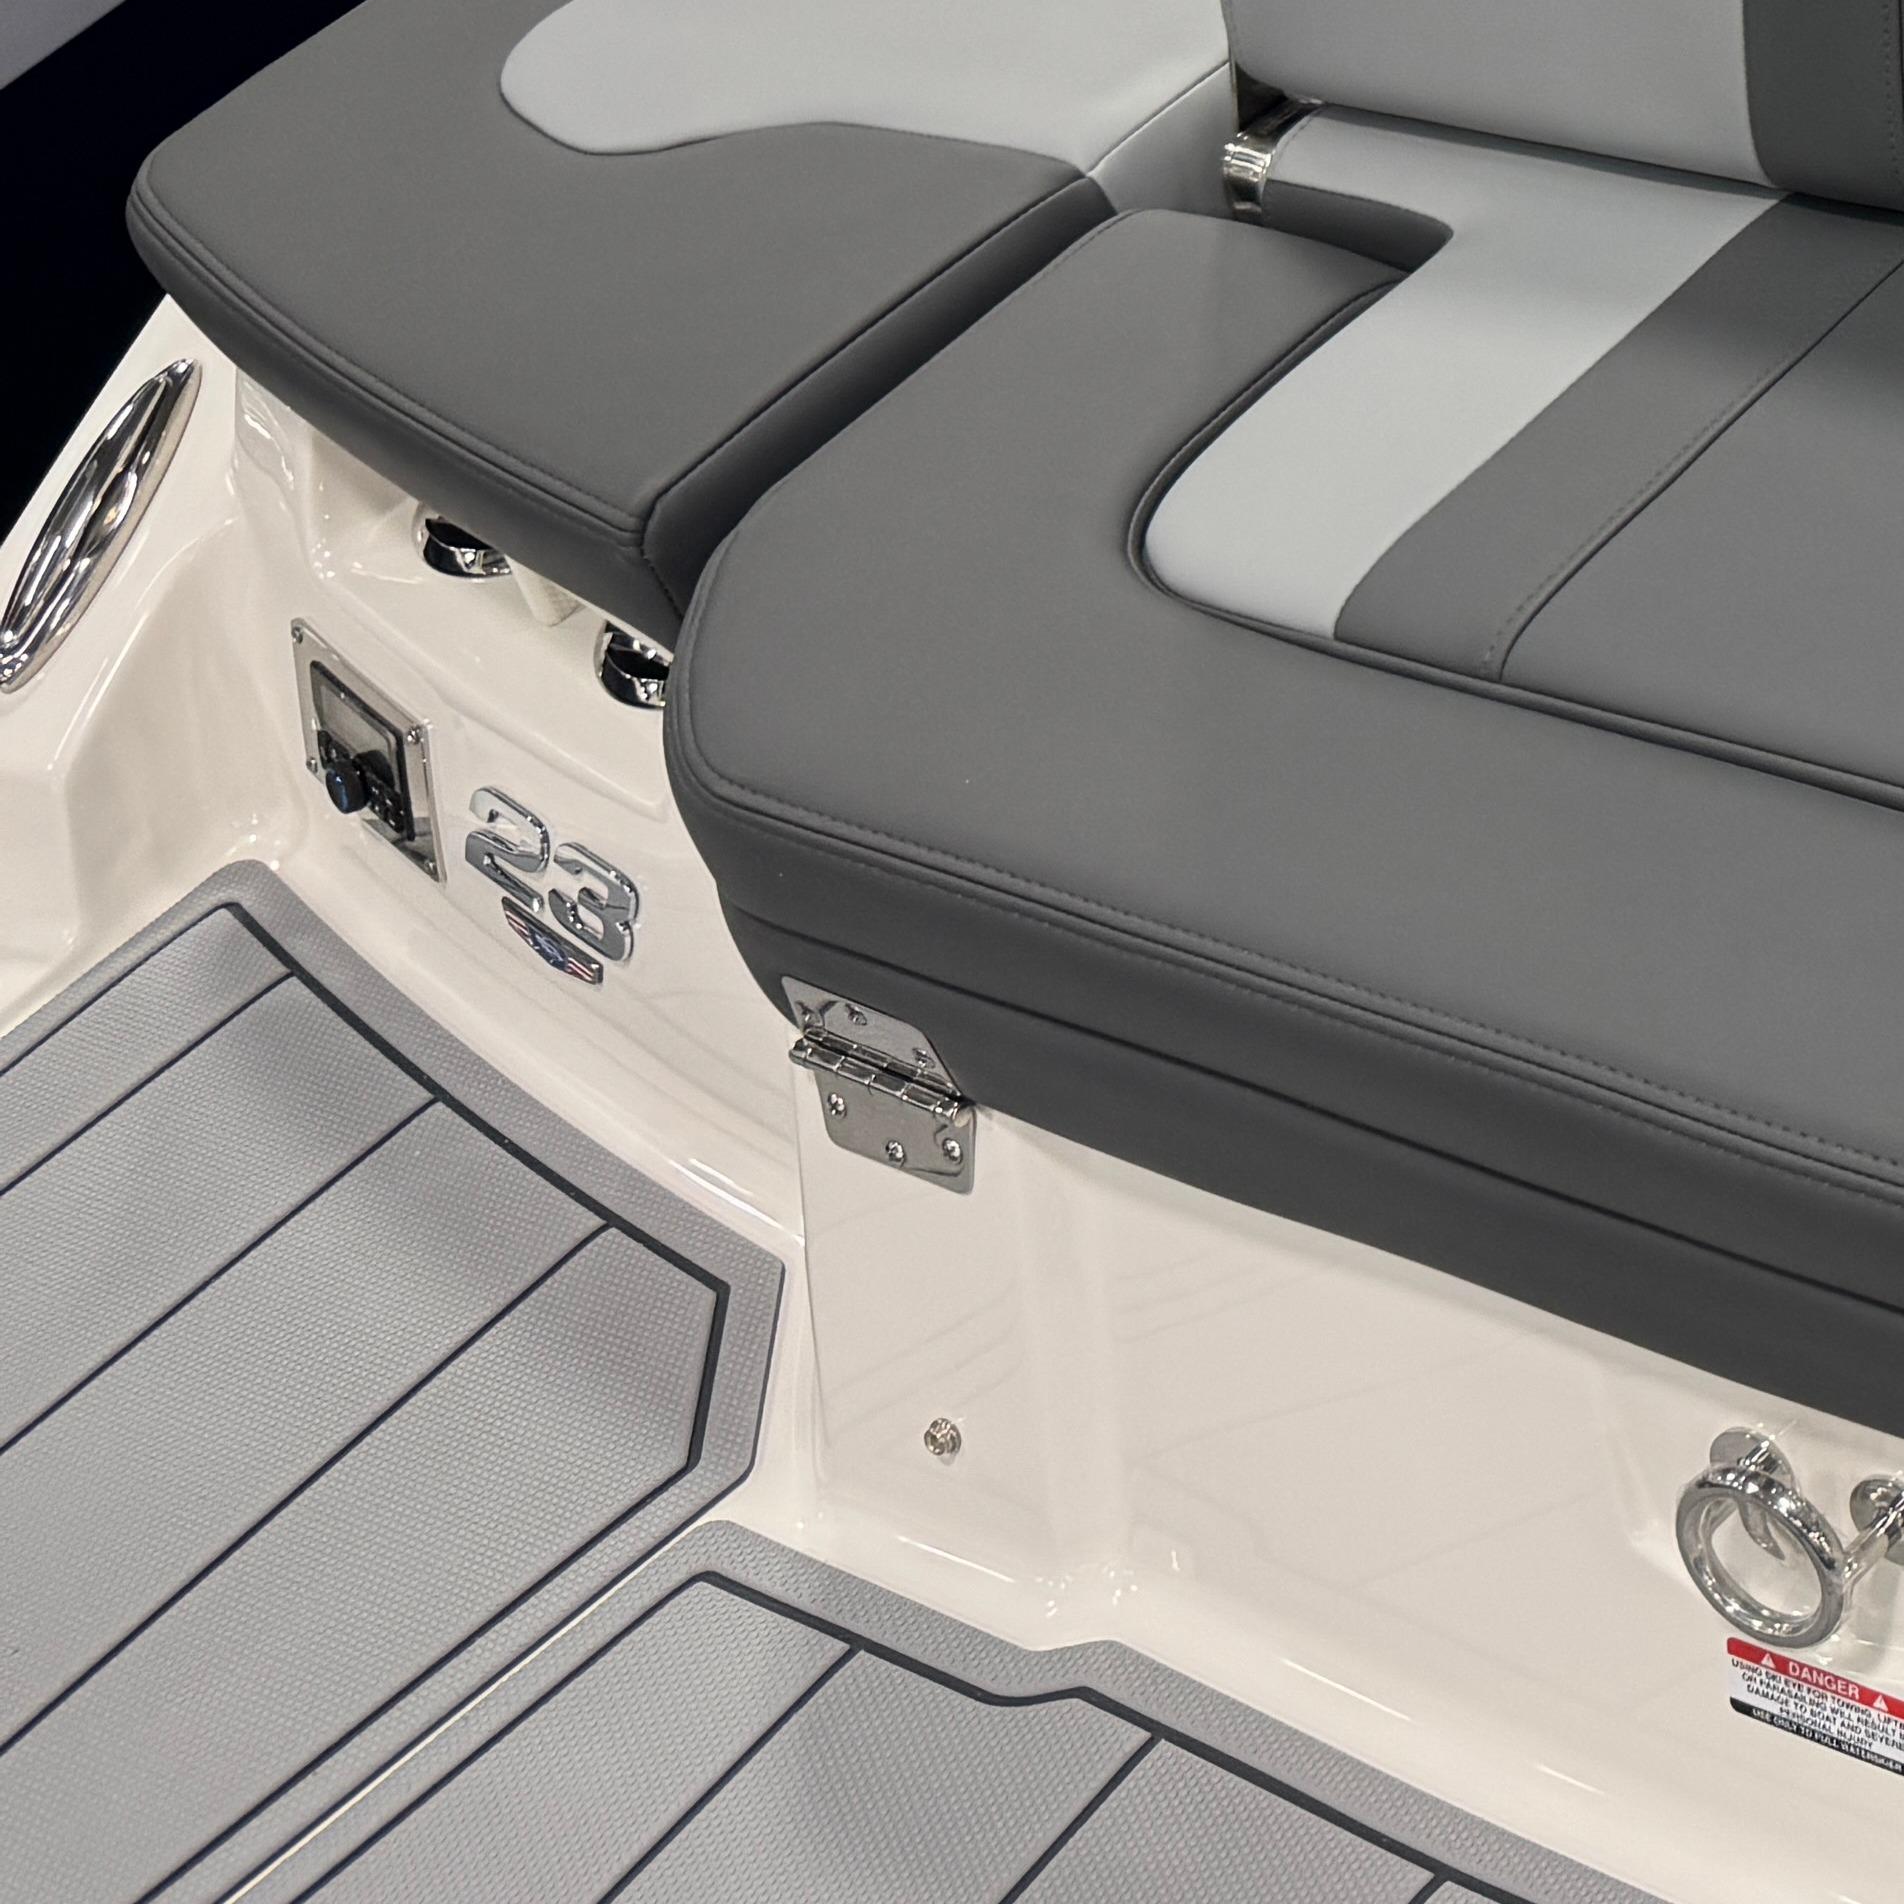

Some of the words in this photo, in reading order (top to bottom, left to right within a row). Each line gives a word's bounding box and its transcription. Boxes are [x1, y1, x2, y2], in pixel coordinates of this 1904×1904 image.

[466, 787, 640, 962] 23
[1788, 1661, 1860, 1701] DANGER
[1745, 1682, 1790, 1709] DAMAGE
[1793, 1700, 1807, 1715] TO
[1809, 1706, 1836, 1726] BOAT
[1839, 1718, 1861, 1735] AND
[1855, 1714, 1897, 1739] RESULT
